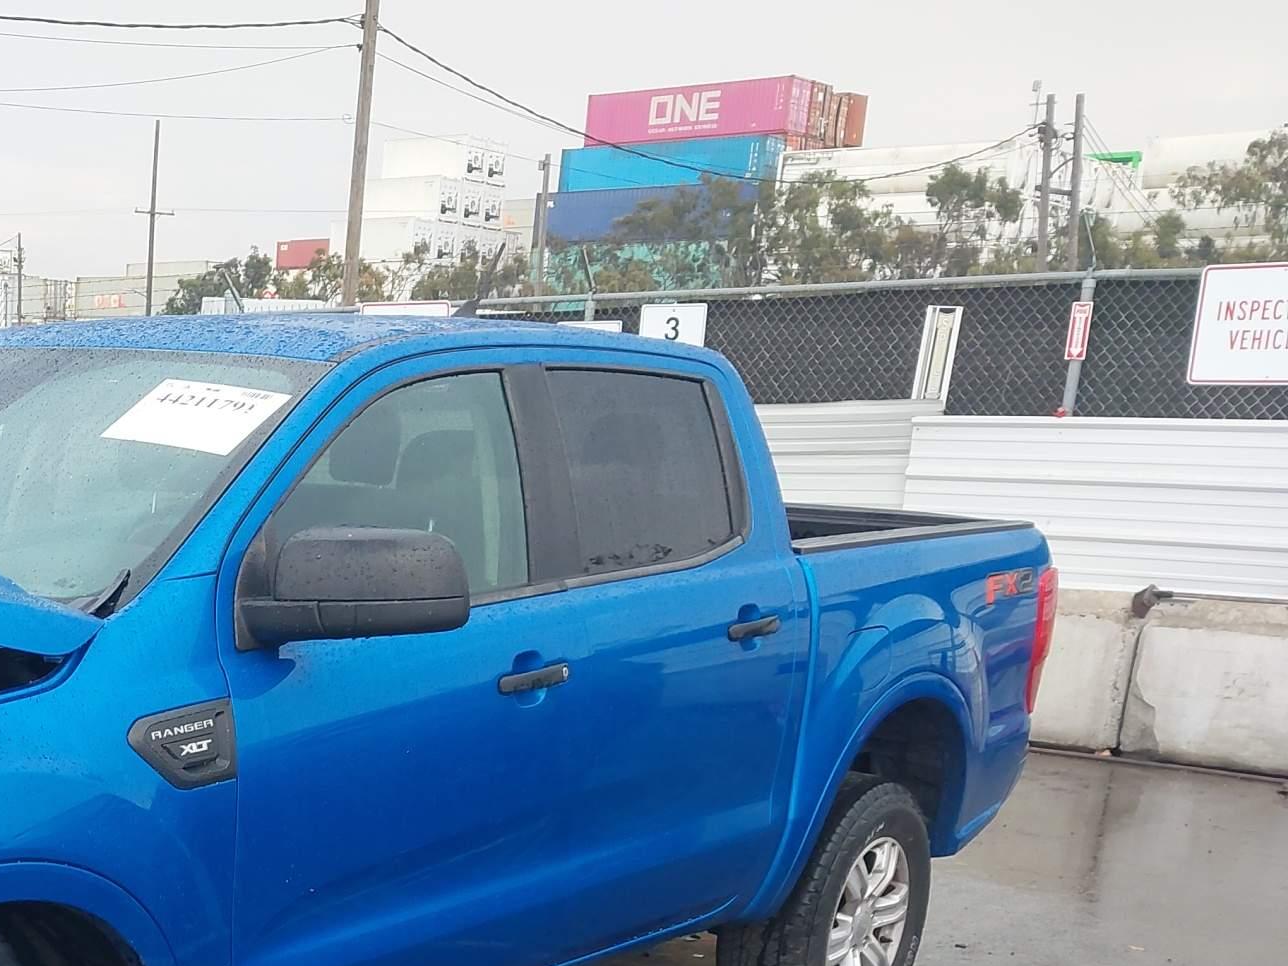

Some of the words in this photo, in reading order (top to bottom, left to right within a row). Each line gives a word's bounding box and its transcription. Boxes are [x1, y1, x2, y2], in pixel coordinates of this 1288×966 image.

[648, 90, 722, 125] ONE
[1216, 299, 1288, 321] INSPEC
[664, 316, 680, 341] 3
[985, 570, 1033, 604] FX2
[151, 719, 214, 740] RANGER
[179, 739, 212, 756] XLT
